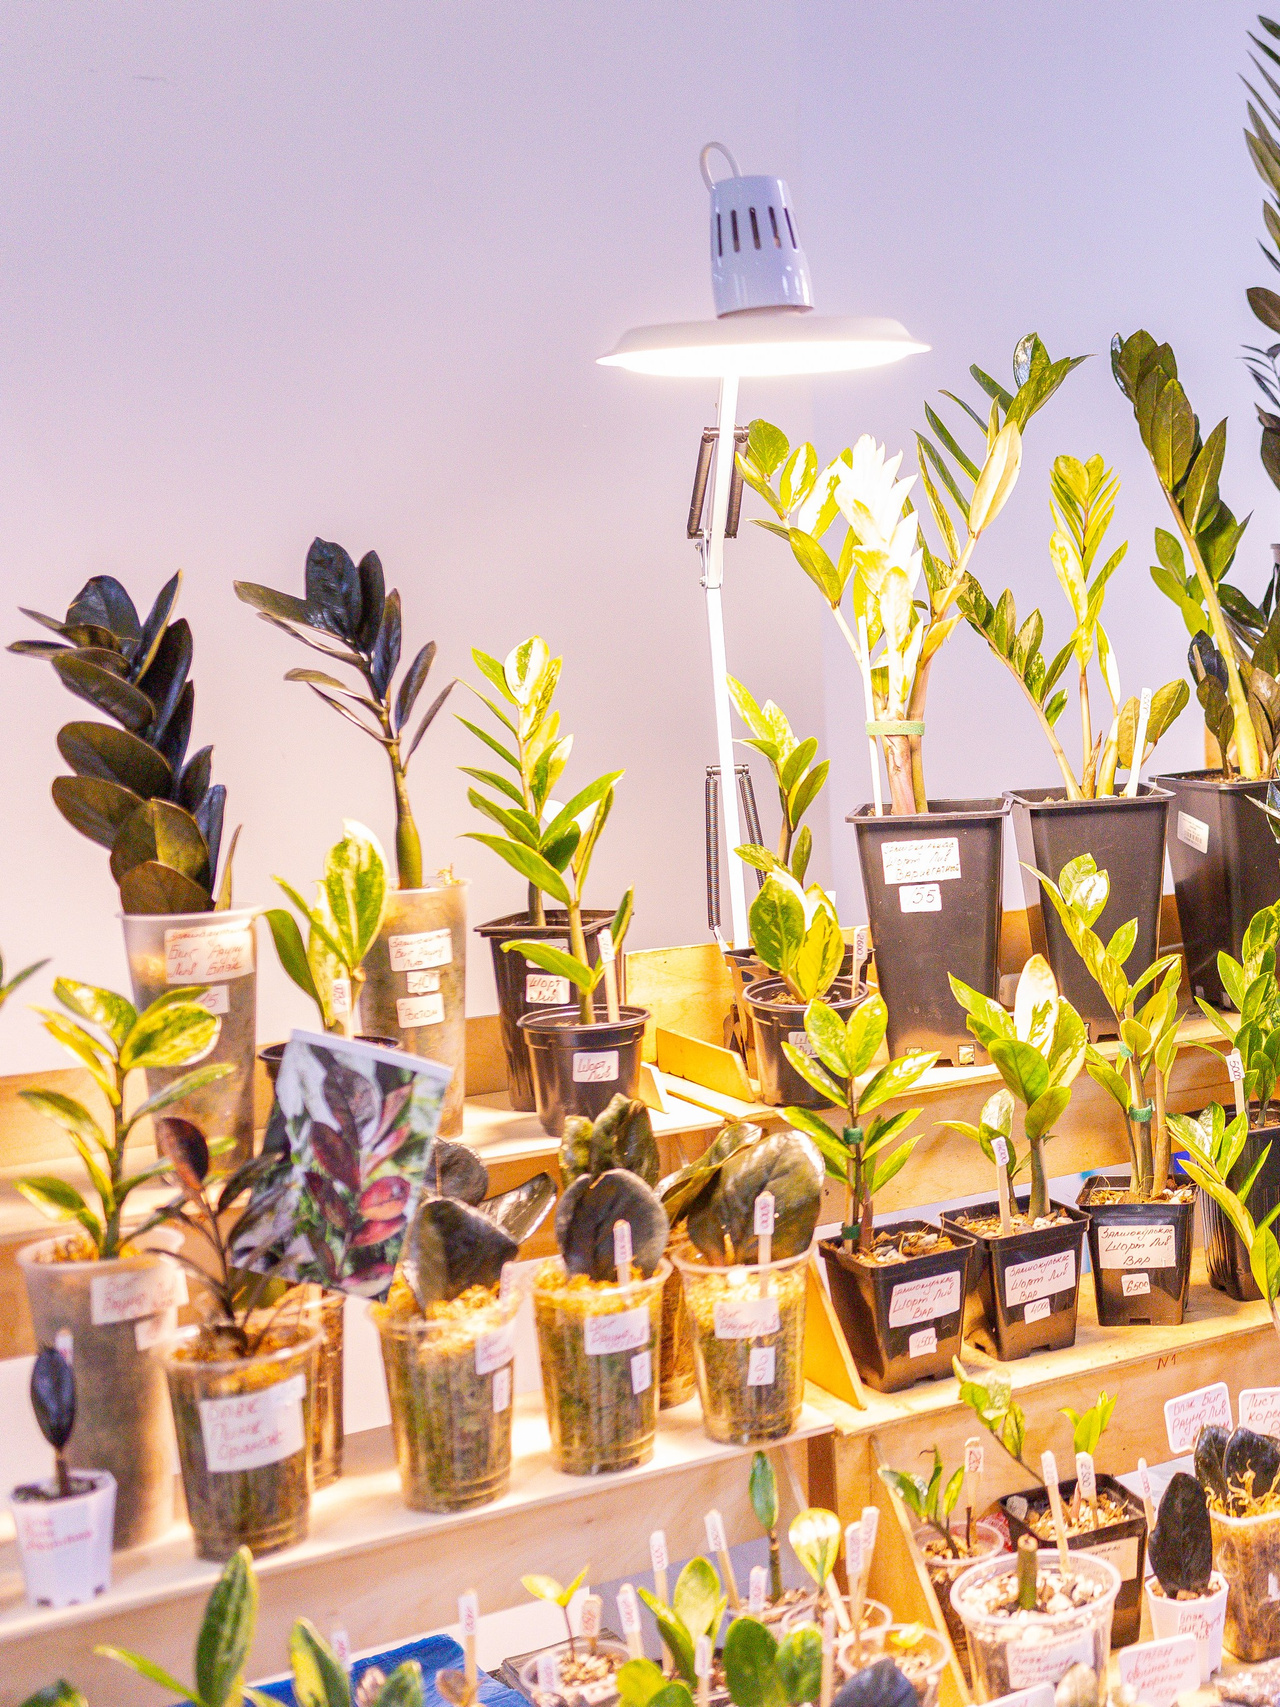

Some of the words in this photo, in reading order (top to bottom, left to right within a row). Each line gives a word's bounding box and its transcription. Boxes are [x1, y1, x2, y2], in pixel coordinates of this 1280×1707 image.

[1230, 1060, 1242, 1081] 5000
[1104, 1240, 1145, 1255] Шорт
[1125, 1279, 1149, 1294] 6500
